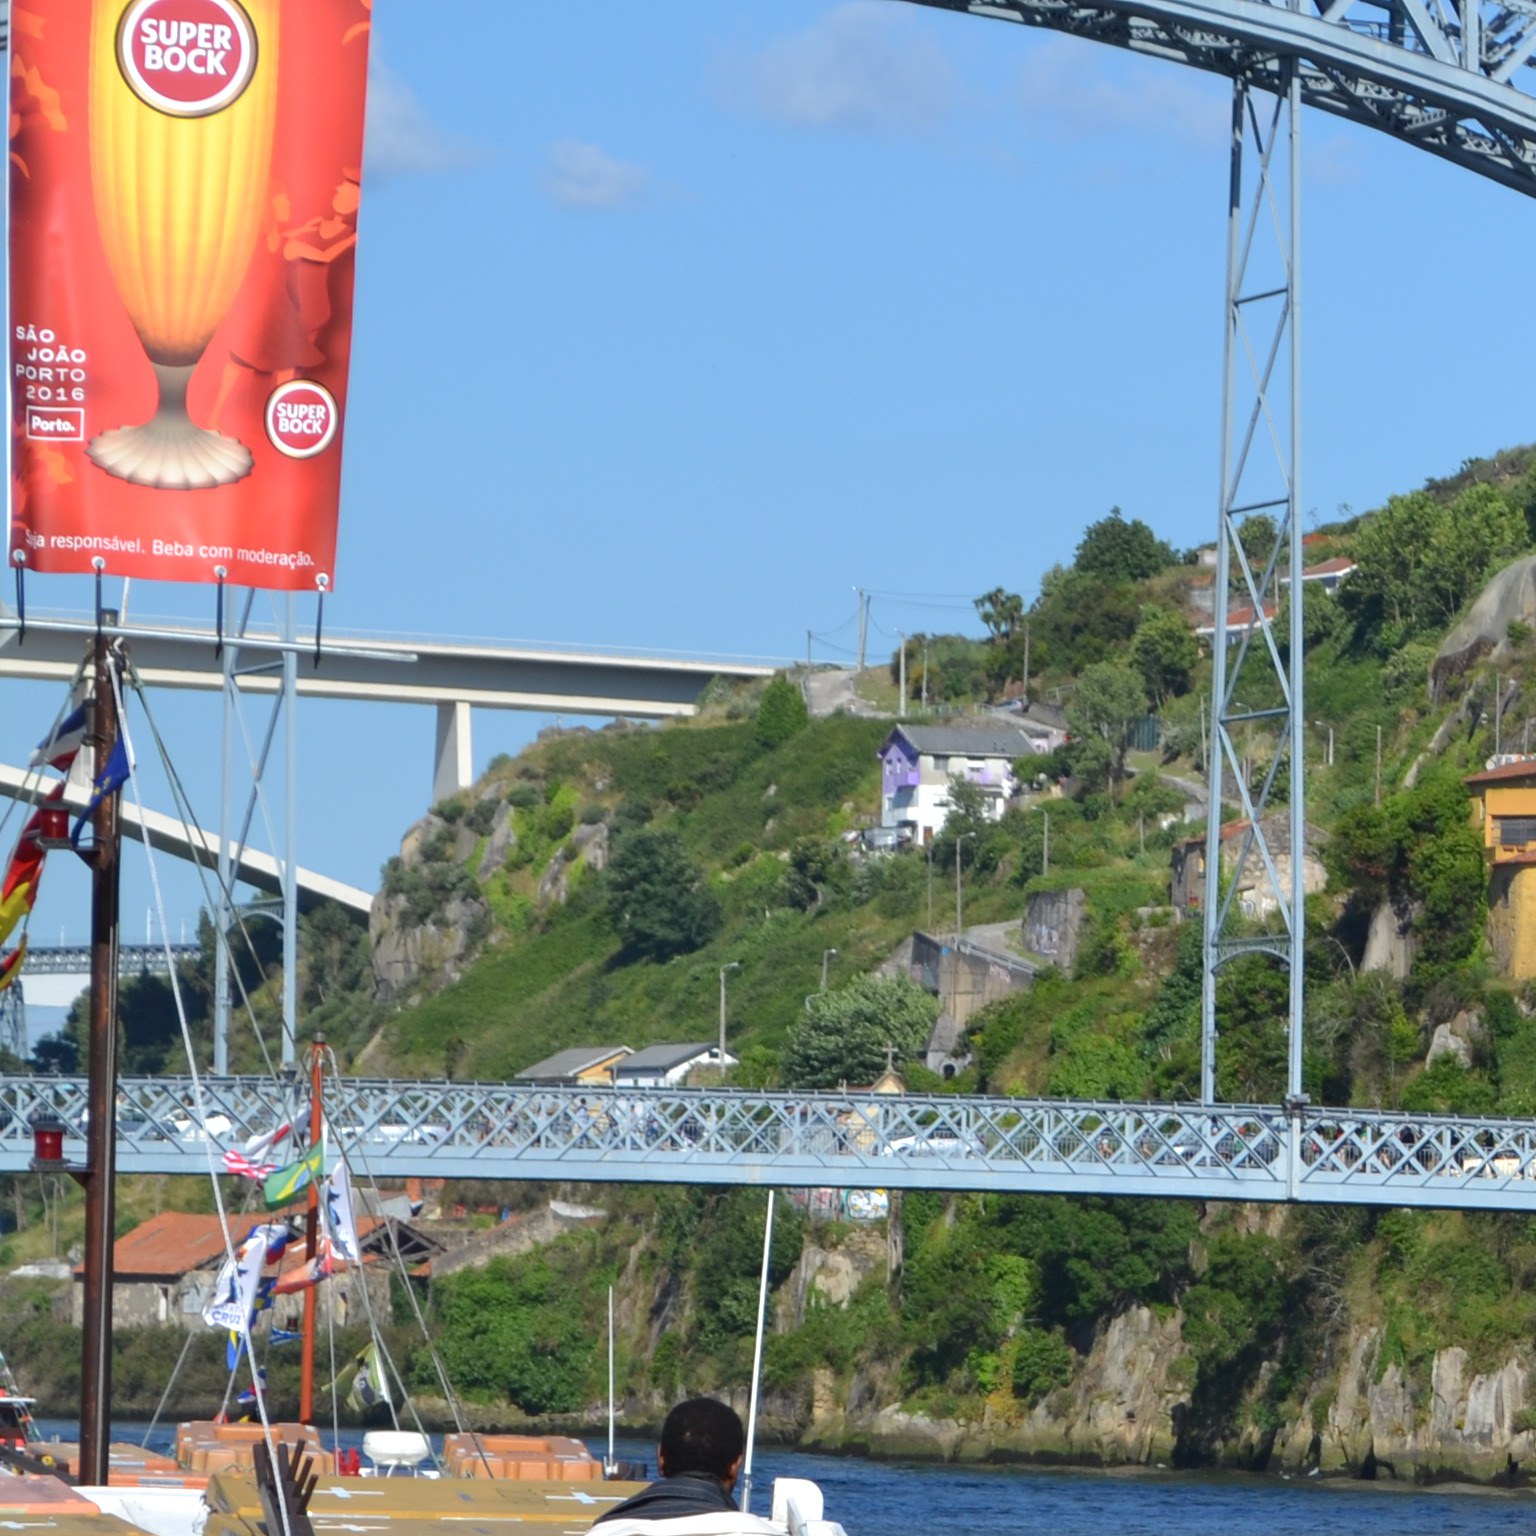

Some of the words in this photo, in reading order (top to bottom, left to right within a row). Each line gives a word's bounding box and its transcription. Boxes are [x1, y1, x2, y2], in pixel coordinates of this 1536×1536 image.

[141, 18, 232, 51] SUPER
[144, 44, 228, 76] BOCK
[15, 323, 55, 343] SÃO
[27, 344, 86, 363] JOÃO
[15, 363, 86, 382] PORTO
[26, 385, 85, 401] 2016
[276, 402, 326, 420] SUPER
[278, 417, 323, 434] BOCK
[50, 532, 145, 555] responsável.
[152, 539, 194, 557] Beba
[199, 544, 233, 559] com
[237, 548, 315, 570] moderação.
